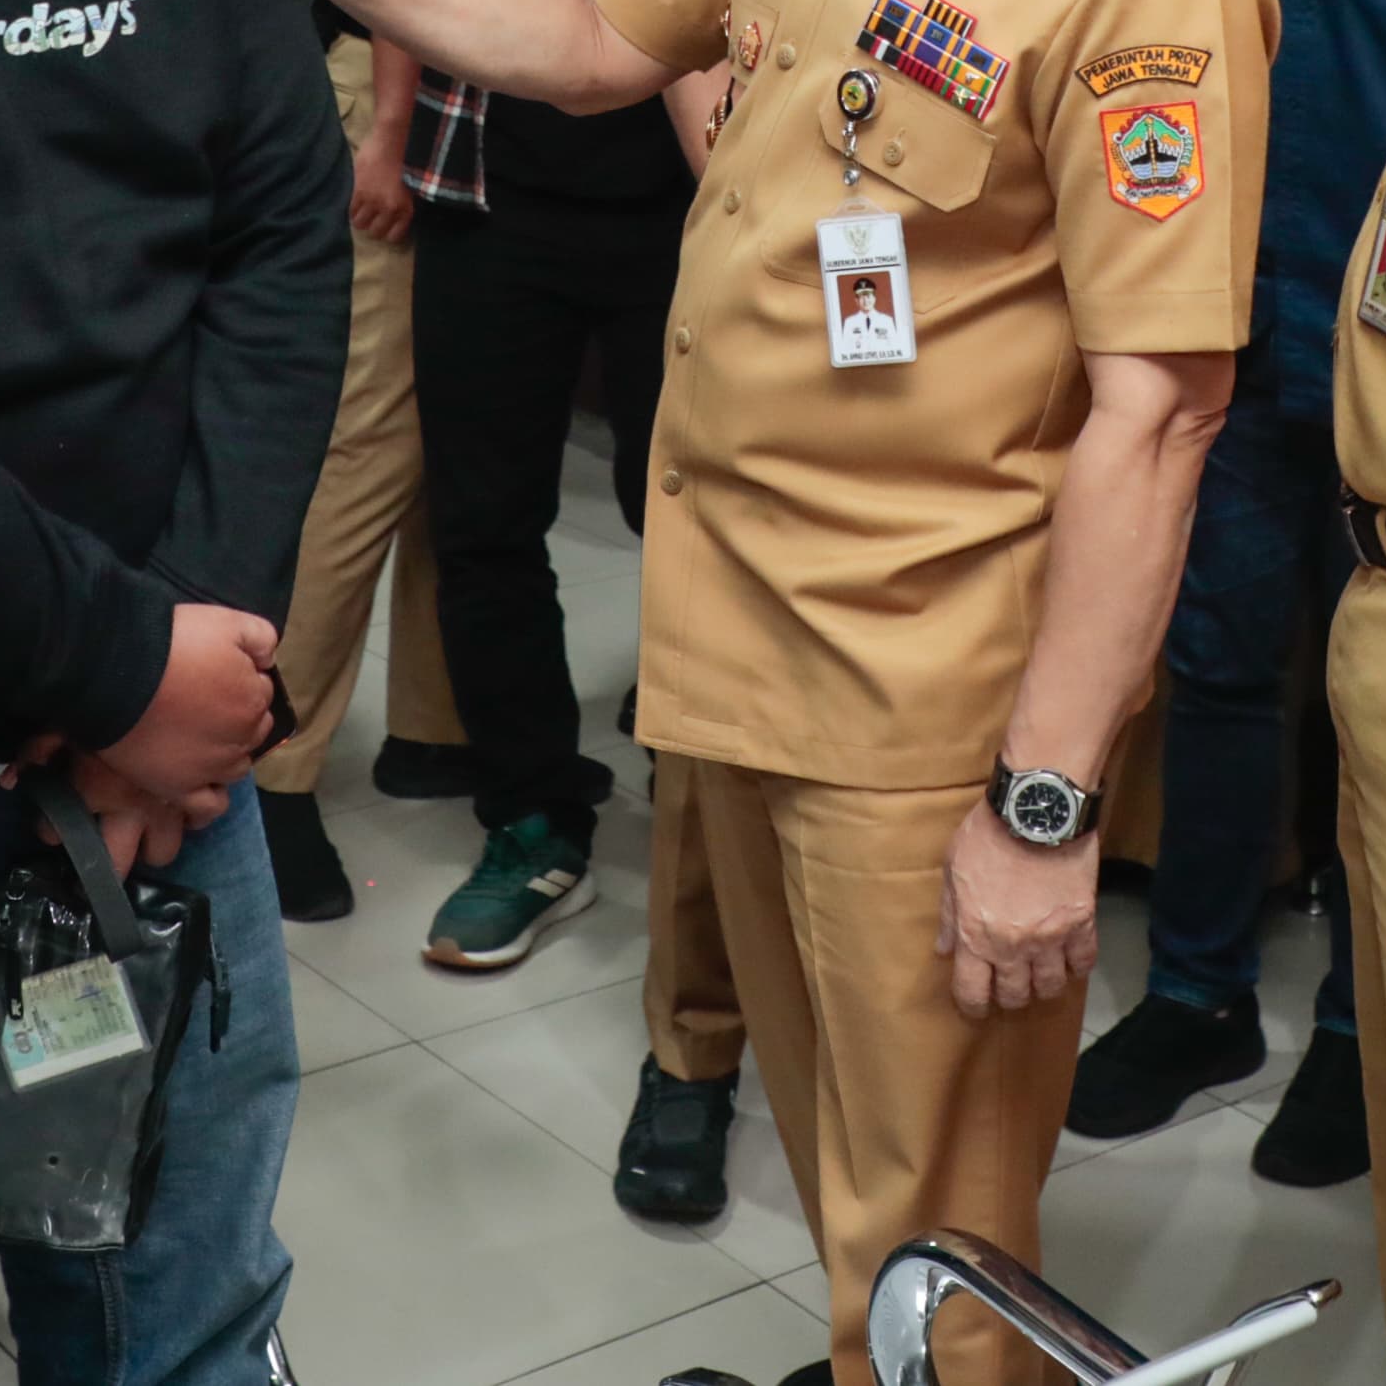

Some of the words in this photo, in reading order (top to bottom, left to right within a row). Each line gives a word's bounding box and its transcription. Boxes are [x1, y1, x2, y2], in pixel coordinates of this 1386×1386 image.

[1083, 48, 1166, 82] PEMERINTAH
[1102, 66, 1137, 90] JAWA
[1141, 64, 1192, 80] TENGAH
